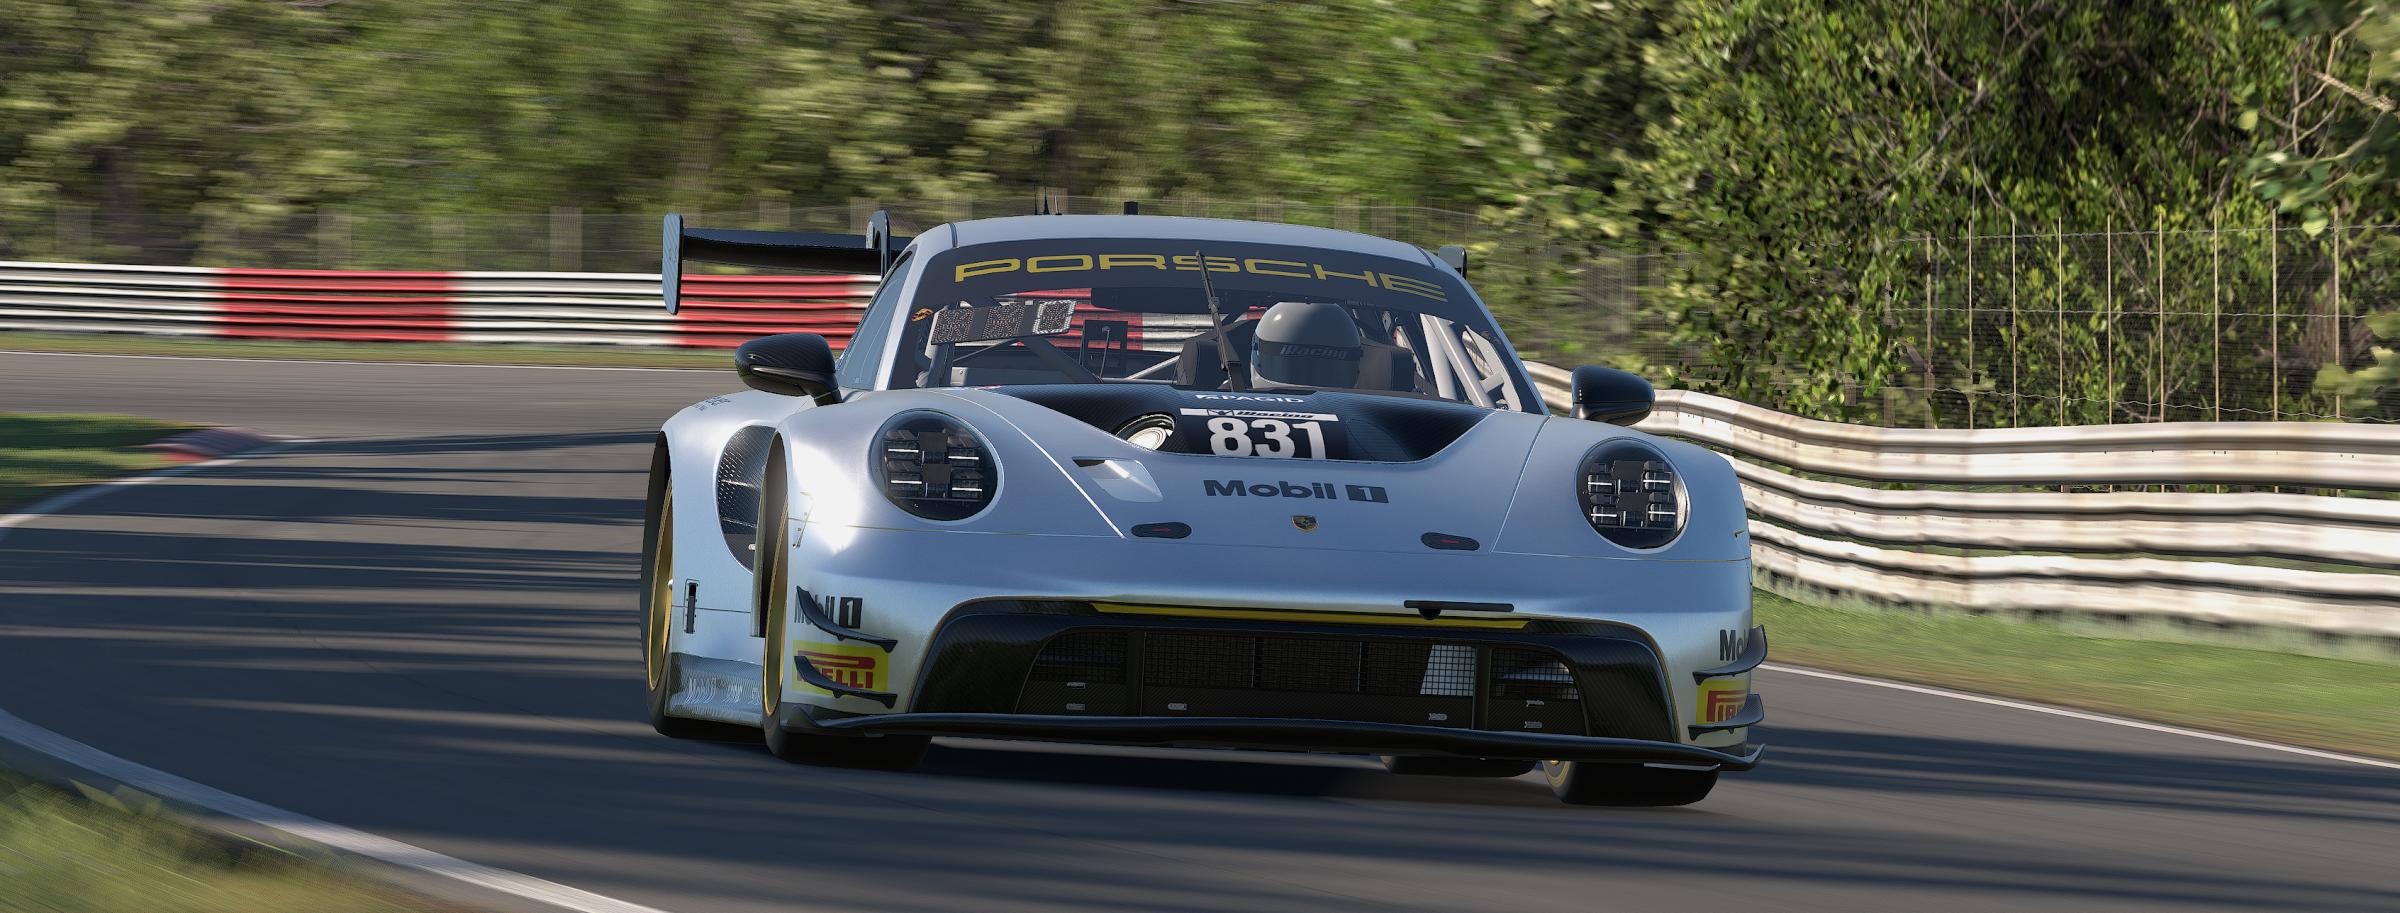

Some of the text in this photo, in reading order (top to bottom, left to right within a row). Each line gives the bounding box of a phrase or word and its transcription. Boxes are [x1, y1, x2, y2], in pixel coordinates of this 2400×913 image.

[955, 254, 1447, 302] PORSCHE
[1221, 395, 1304, 403] PAGID
[1234, 410, 1314, 419] iRacing
[1207, 417, 1326, 460] 831
[1203, 479, 1337, 500] Mobil
